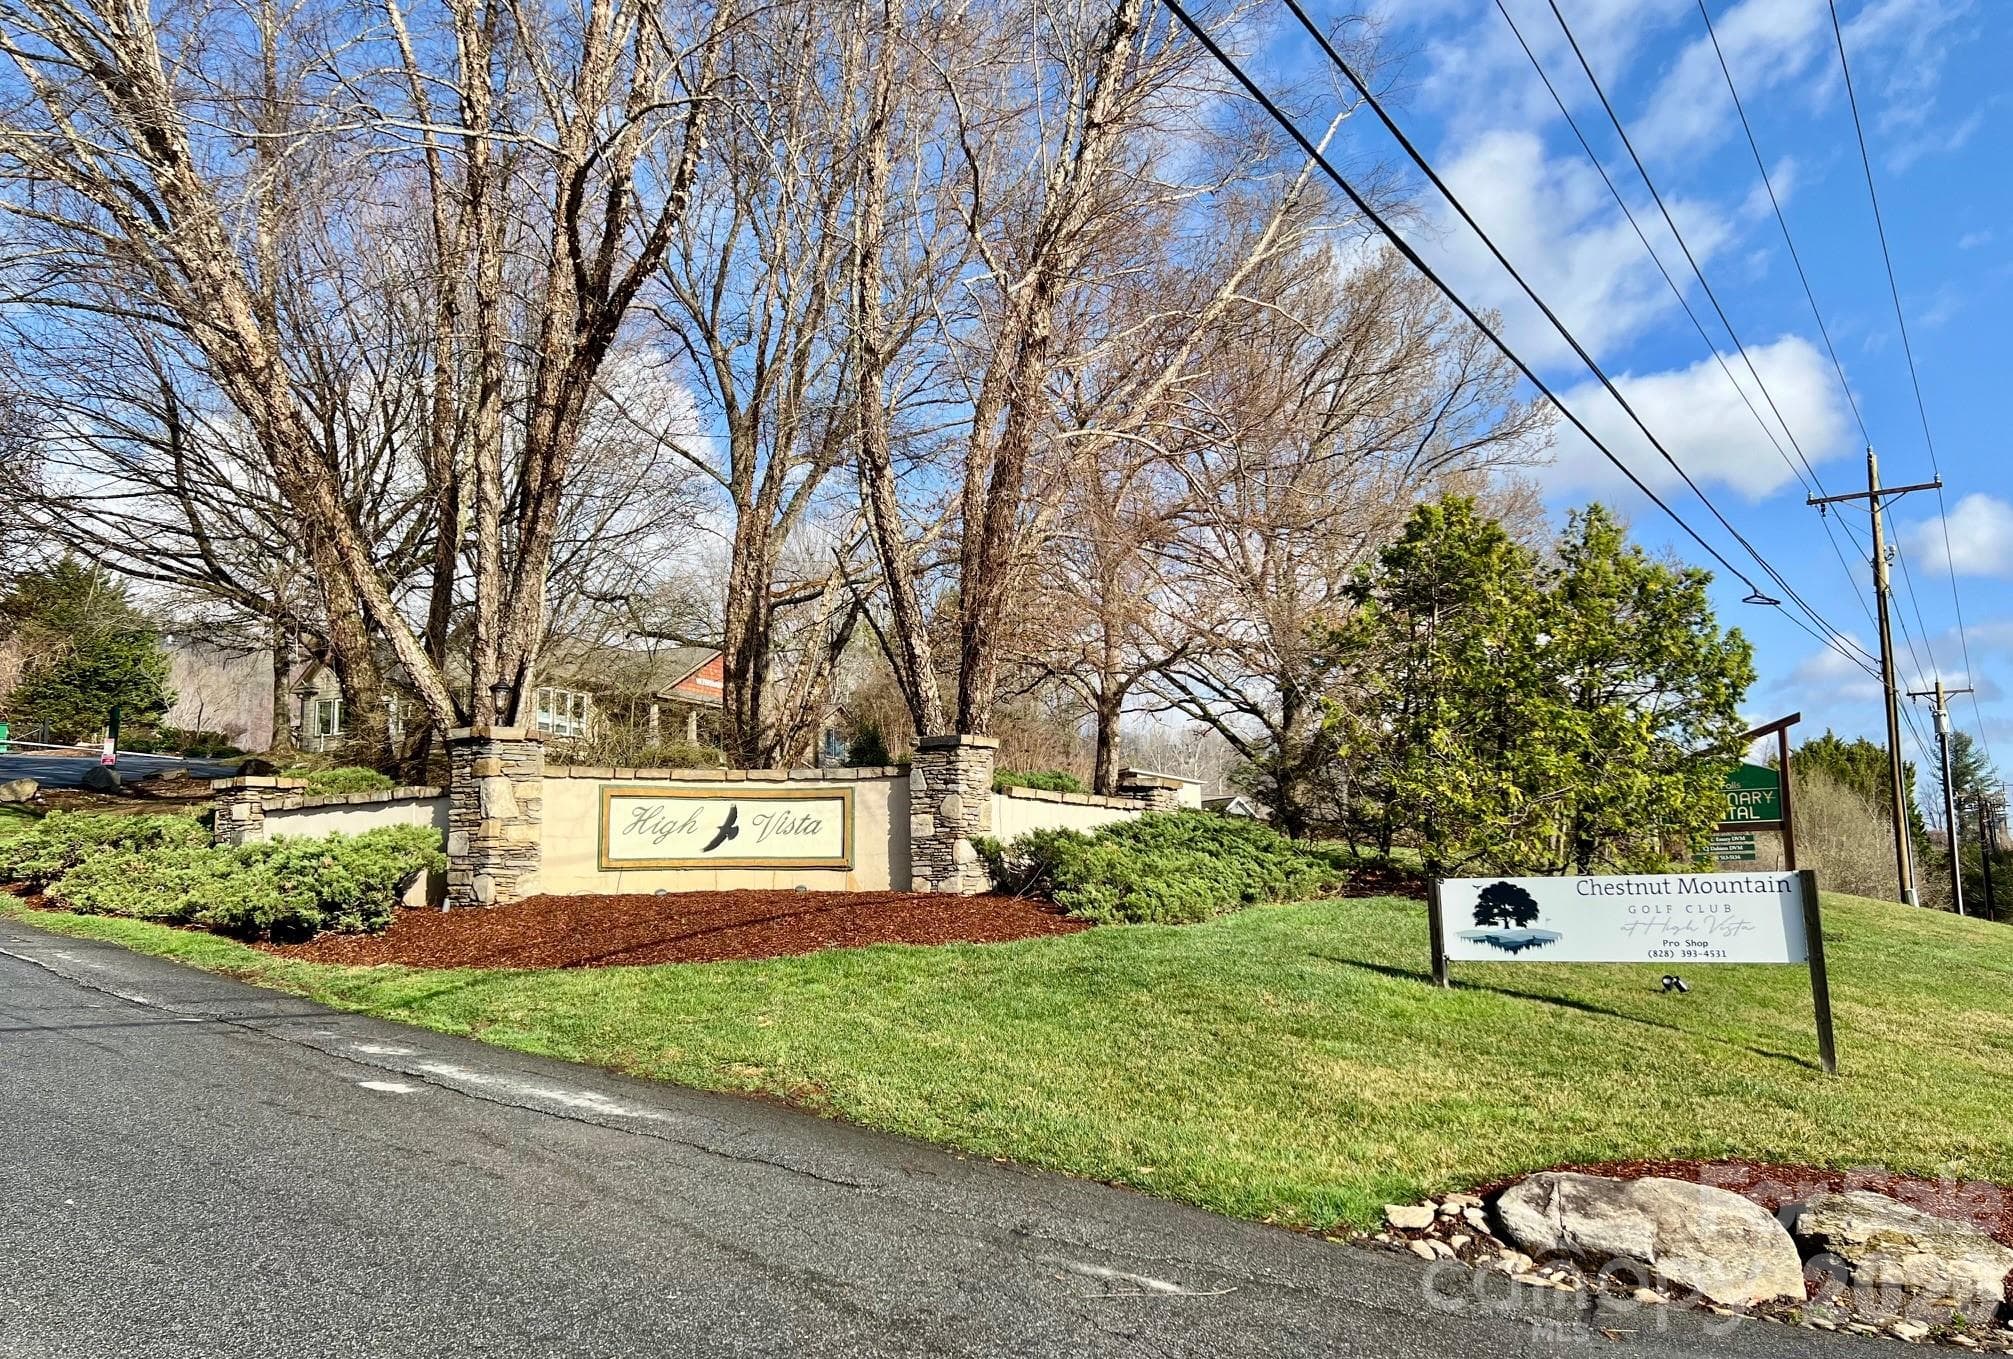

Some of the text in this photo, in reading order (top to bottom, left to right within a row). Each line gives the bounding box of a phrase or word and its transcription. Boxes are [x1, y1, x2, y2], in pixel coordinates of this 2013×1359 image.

[622, 804, 823, 845] High Vista
[1576, 876, 1792, 896] Chestnut Mountain
[1628, 904, 1732, 914] GOLF CLUB
[1642, 916, 1699, 937] High
[1703, 914, 1756, 938] Vista
[1662, 939, 1709, 949] Pro Shop
[1647, 949, 1727, 959] (828) 393-4531
